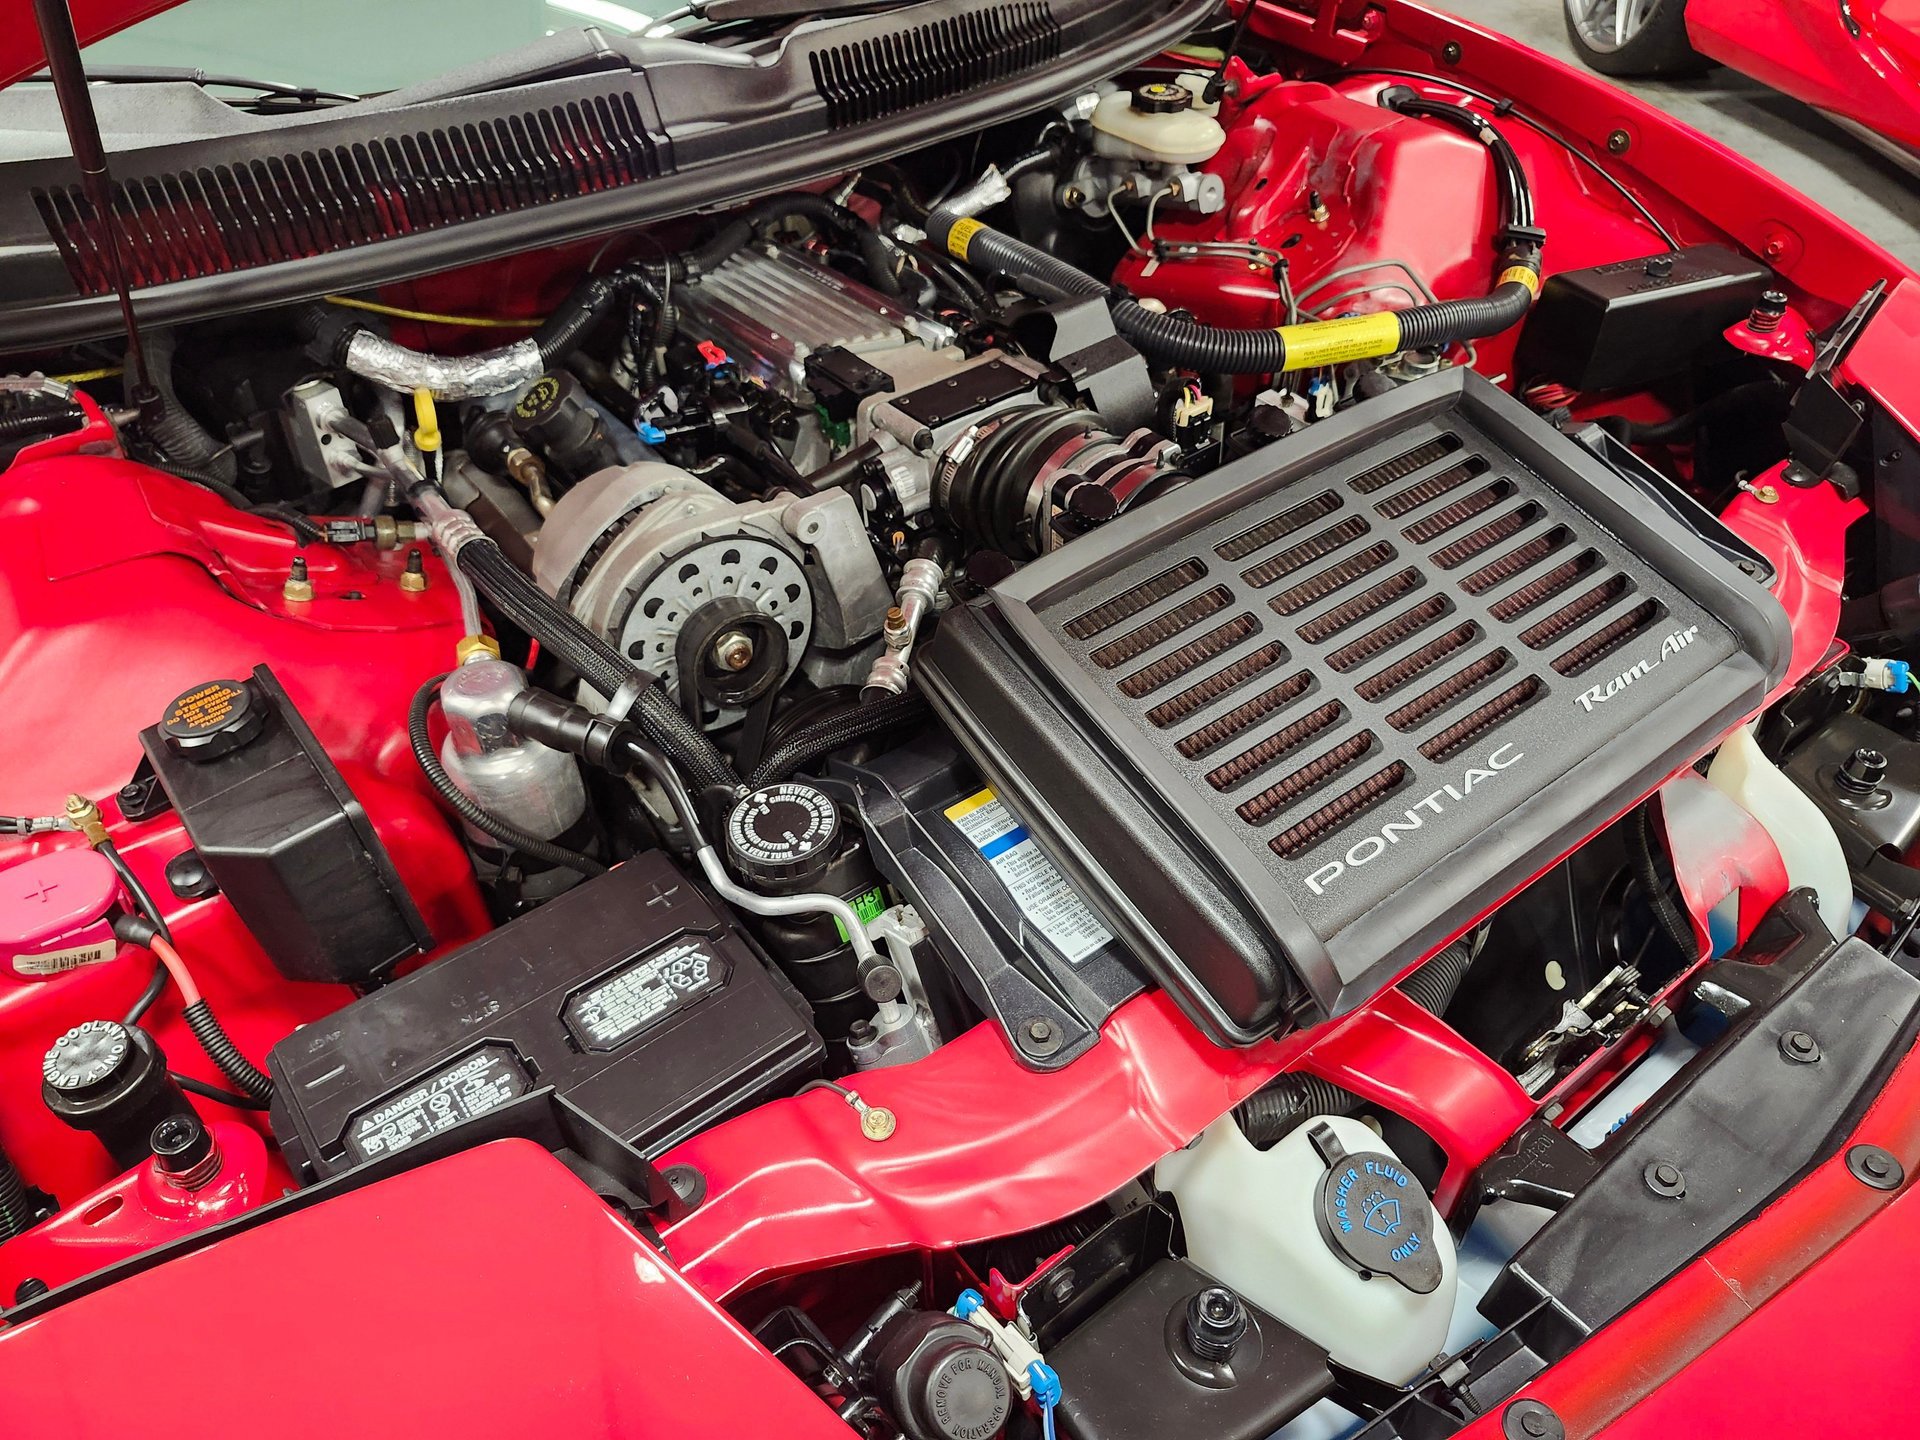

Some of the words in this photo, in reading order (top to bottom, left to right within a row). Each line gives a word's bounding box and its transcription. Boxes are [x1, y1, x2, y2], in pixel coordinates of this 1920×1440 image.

[1574, 657, 1660, 714] Ram
[1659, 625, 1699, 664] Air
[175, 688, 231, 716] STEERING
[178, 684, 220, 706] POWER
[166, 717, 180, 726] DO
[183, 708, 200, 719] NOT
[204, 689, 243, 709] OVERFILL
[186, 712, 204, 723] USE
[208, 701, 228, 713] ONLY
[189, 705, 232, 728] APPROVED
[200, 714, 225, 728] FLUID
[769, 794, 796, 804] CHECK
[779, 786, 815, 799] NEVER
[795, 796, 816, 812] LEVEL
[732, 802, 750, 822] ALIGN
[810, 809, 819, 818] IN
[812, 795, 832, 817] OPEN
[801, 817, 820, 840] BOTTLE
[818, 817, 833, 836] HOT
[960, 812, 987, 827] WITHOUT
[995, 822, 1011, 832] HIGH
[1303, 742, 1525, 896] PONTIAC
[731, 821, 747, 845] ARROW
[743, 823, 762, 845] CLOSED
[758, 840, 790, 851] SYSTEM
[747, 846, 771, 858] VENT
[770, 850, 794, 859] TUBE
[993, 856, 1006, 865] AIR
[1003, 850, 1018, 859] BAG
[1012, 881, 1027, 891] THIS
[1024, 868, 1050, 884] VEHICLE
[1025, 901, 1038, 911] USE
[1036, 887, 1063, 904] ORANGE
[55, 1020, 127, 1047] COOLANT
[43, 1050, 80, 1087] ENGINE
[86, 1044, 124, 1082] ONLY
[372, 1086, 429, 1124] DANGER
[437, 1053, 488, 1087] POISON
[1335, 1167, 1359, 1234] WASHER
[1364, 1160, 1409, 1188] FLUID
[1390, 1232, 1422, 1262] ONLY
[950, 1358, 972, 1377] FOR
[976, 1358, 1006, 1400] MANUAL
[936, 1372, 953, 1426] REMOVE
[952, 1404, 1005, 1440] OPERATION
